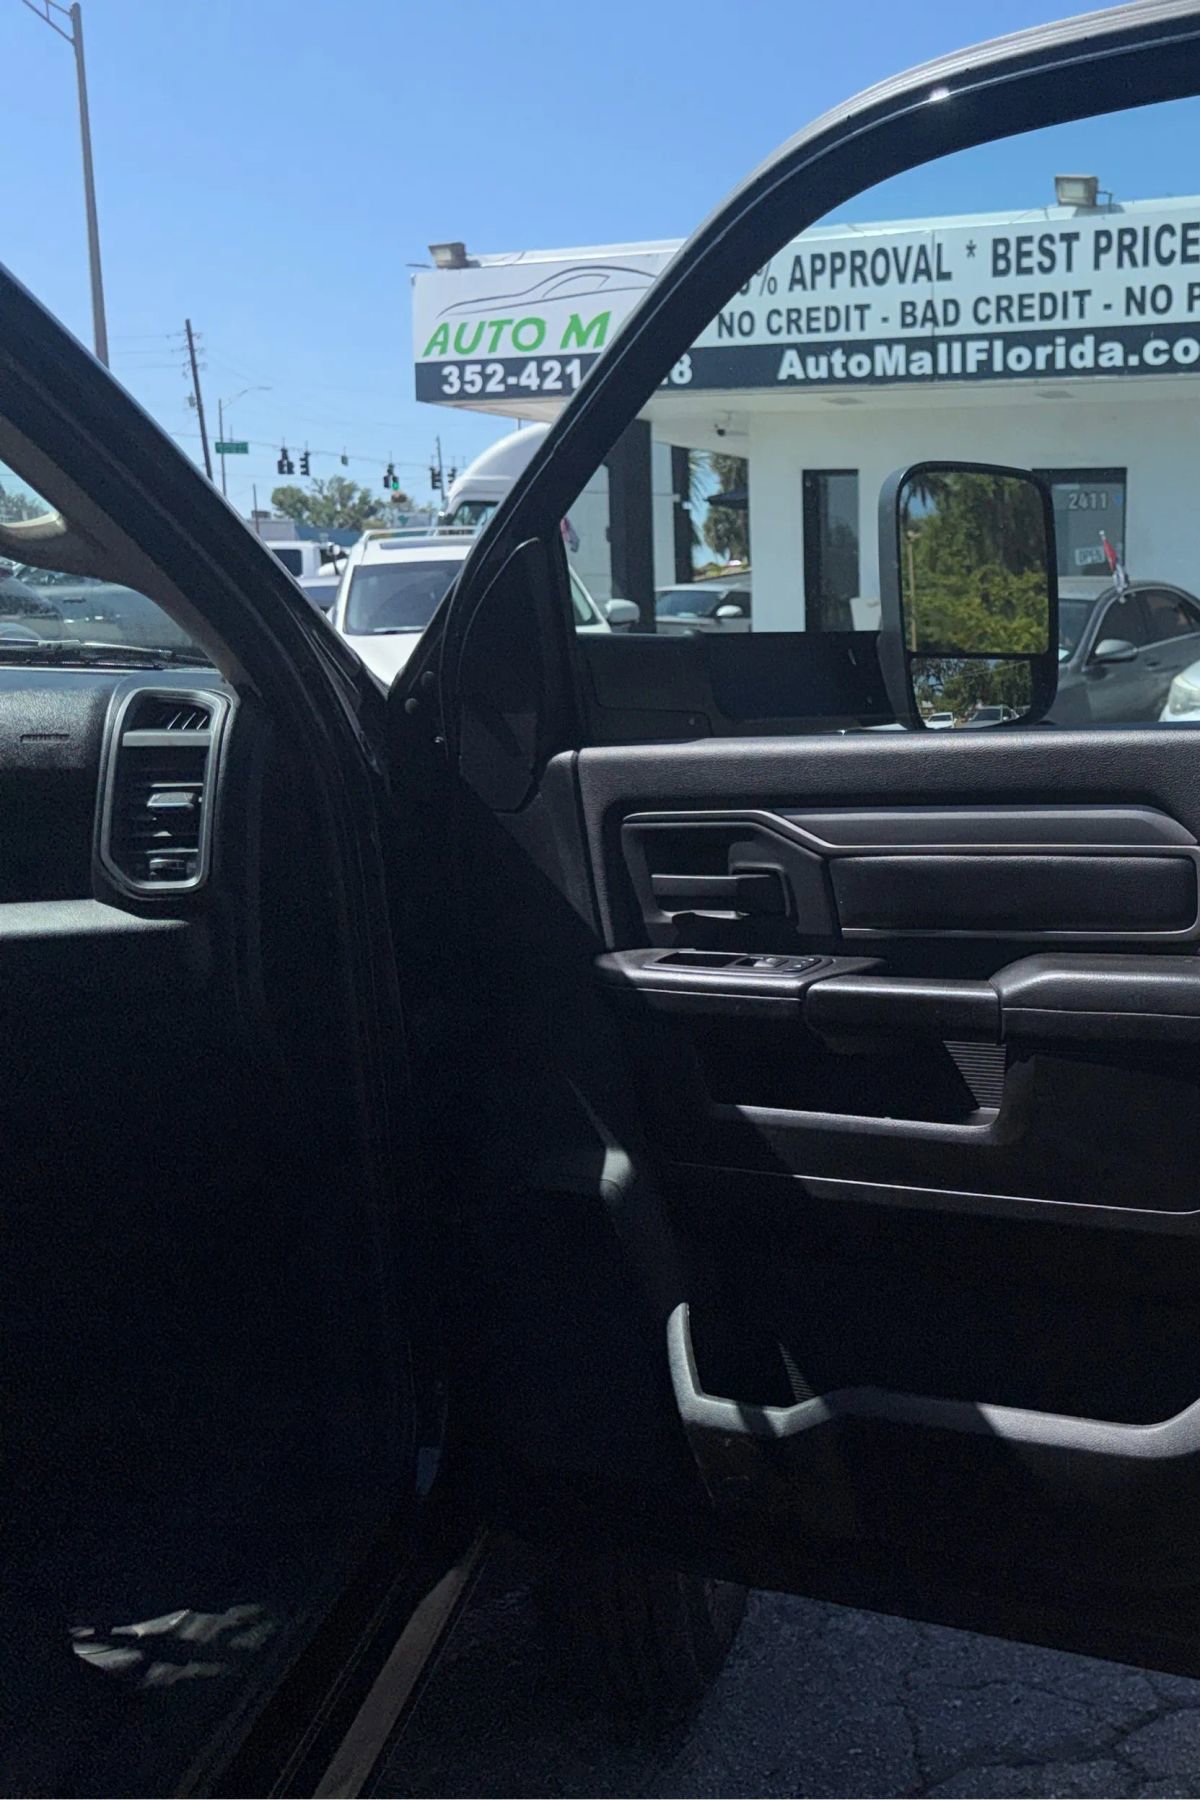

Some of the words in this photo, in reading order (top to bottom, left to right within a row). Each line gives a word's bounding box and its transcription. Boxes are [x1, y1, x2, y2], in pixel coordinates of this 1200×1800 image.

[788, 242, 952, 292] APPROVAL
[991, 231, 1080, 278] BEST
[1093, 221, 1200, 271] PRICE
[717, 310, 755, 339] NO
[766, 303, 871, 336] CREDIT
[900, 299, 960, 330] BAD
[972, 289, 1092, 325] CREDIT
[1125, 283, 1173, 316] NO
[422, 316, 546, 357] AUTO
[1068, 492, 1107, 510] 2411
